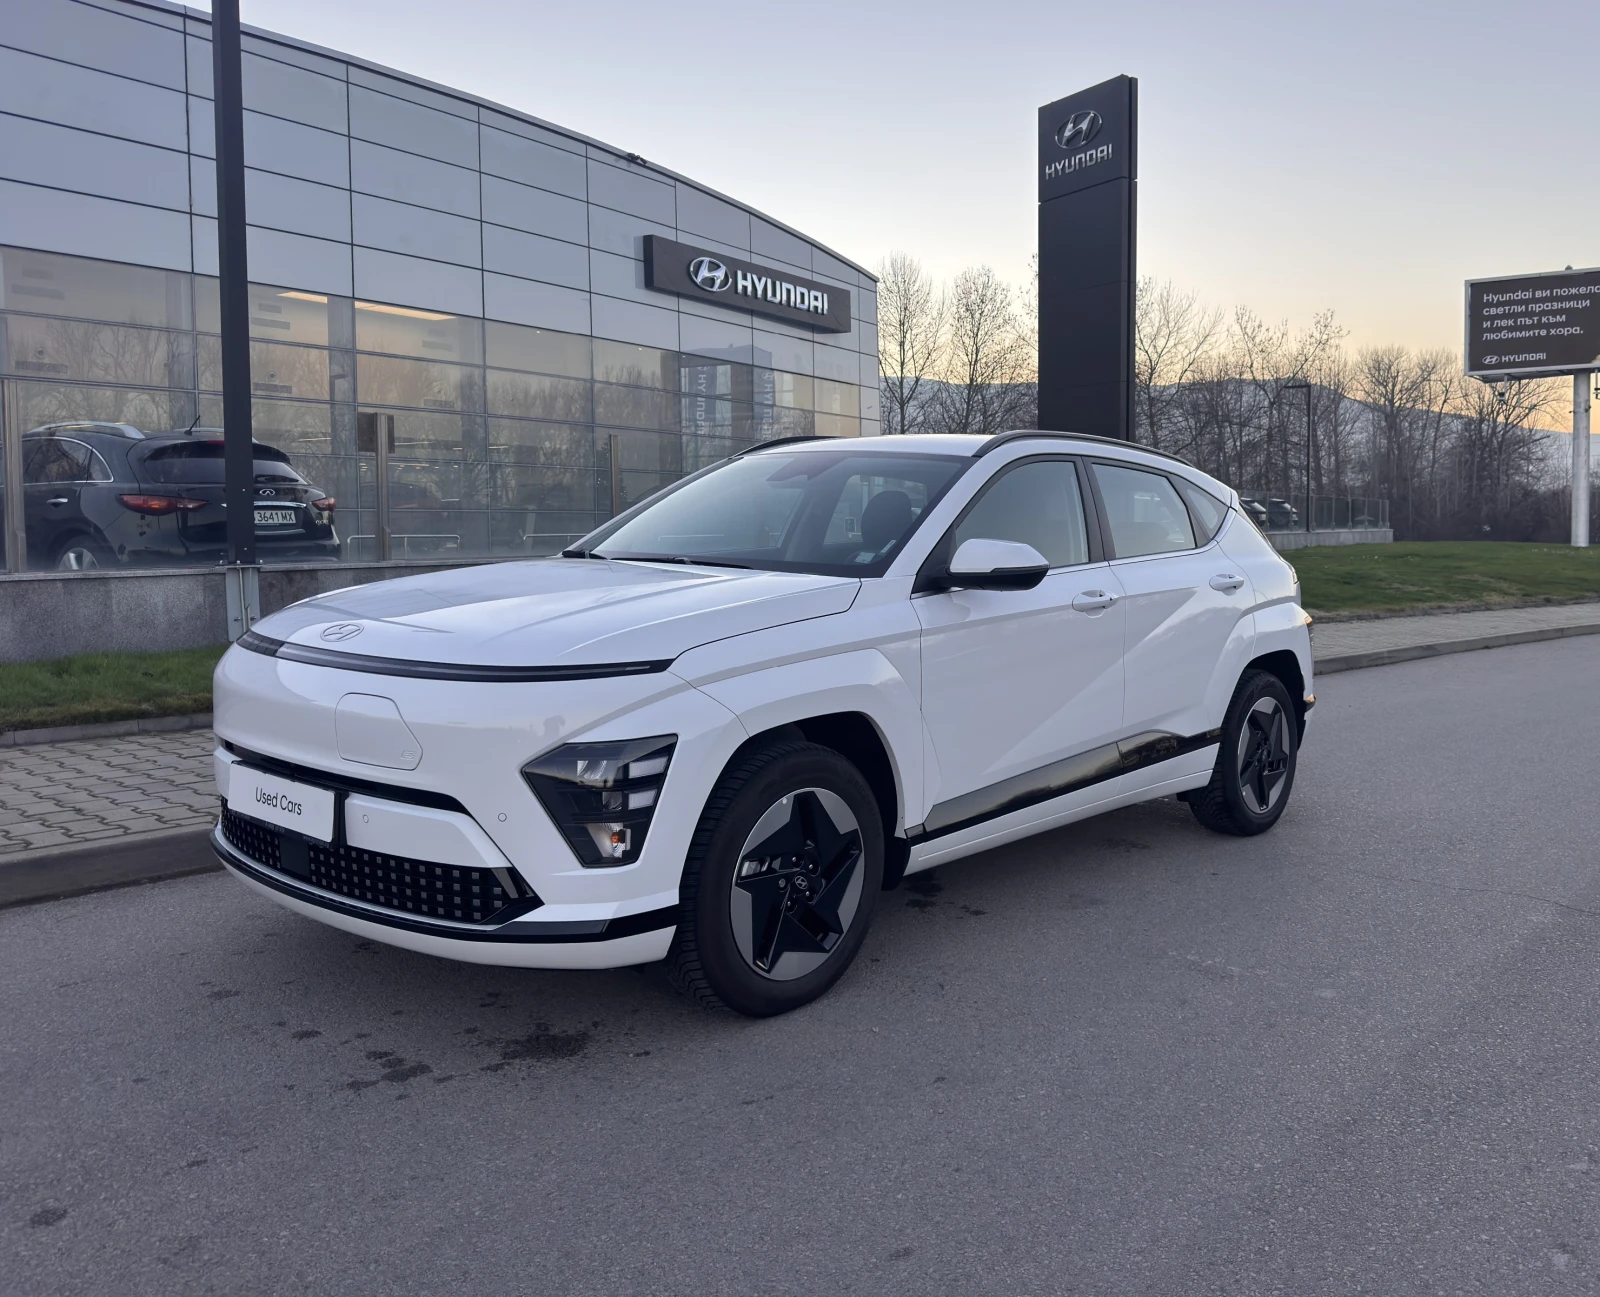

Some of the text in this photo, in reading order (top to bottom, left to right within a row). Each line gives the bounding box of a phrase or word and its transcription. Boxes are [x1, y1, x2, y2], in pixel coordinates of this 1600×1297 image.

[1045, 143, 1113, 180] HYUNDAI
[737, 269, 828, 315] HYUNDAI
[1483, 288, 1533, 303] Hyundai
[1535, 289, 1550, 298] ви
[1483, 299, 1590, 315] светли празници
[1483, 314, 1566, 328] и лек път към
[1482, 326, 1584, 341] любимите хора.
[1501, 352, 1547, 363] HYUNDAI
[255, 786, 302, 816] Used Cars
